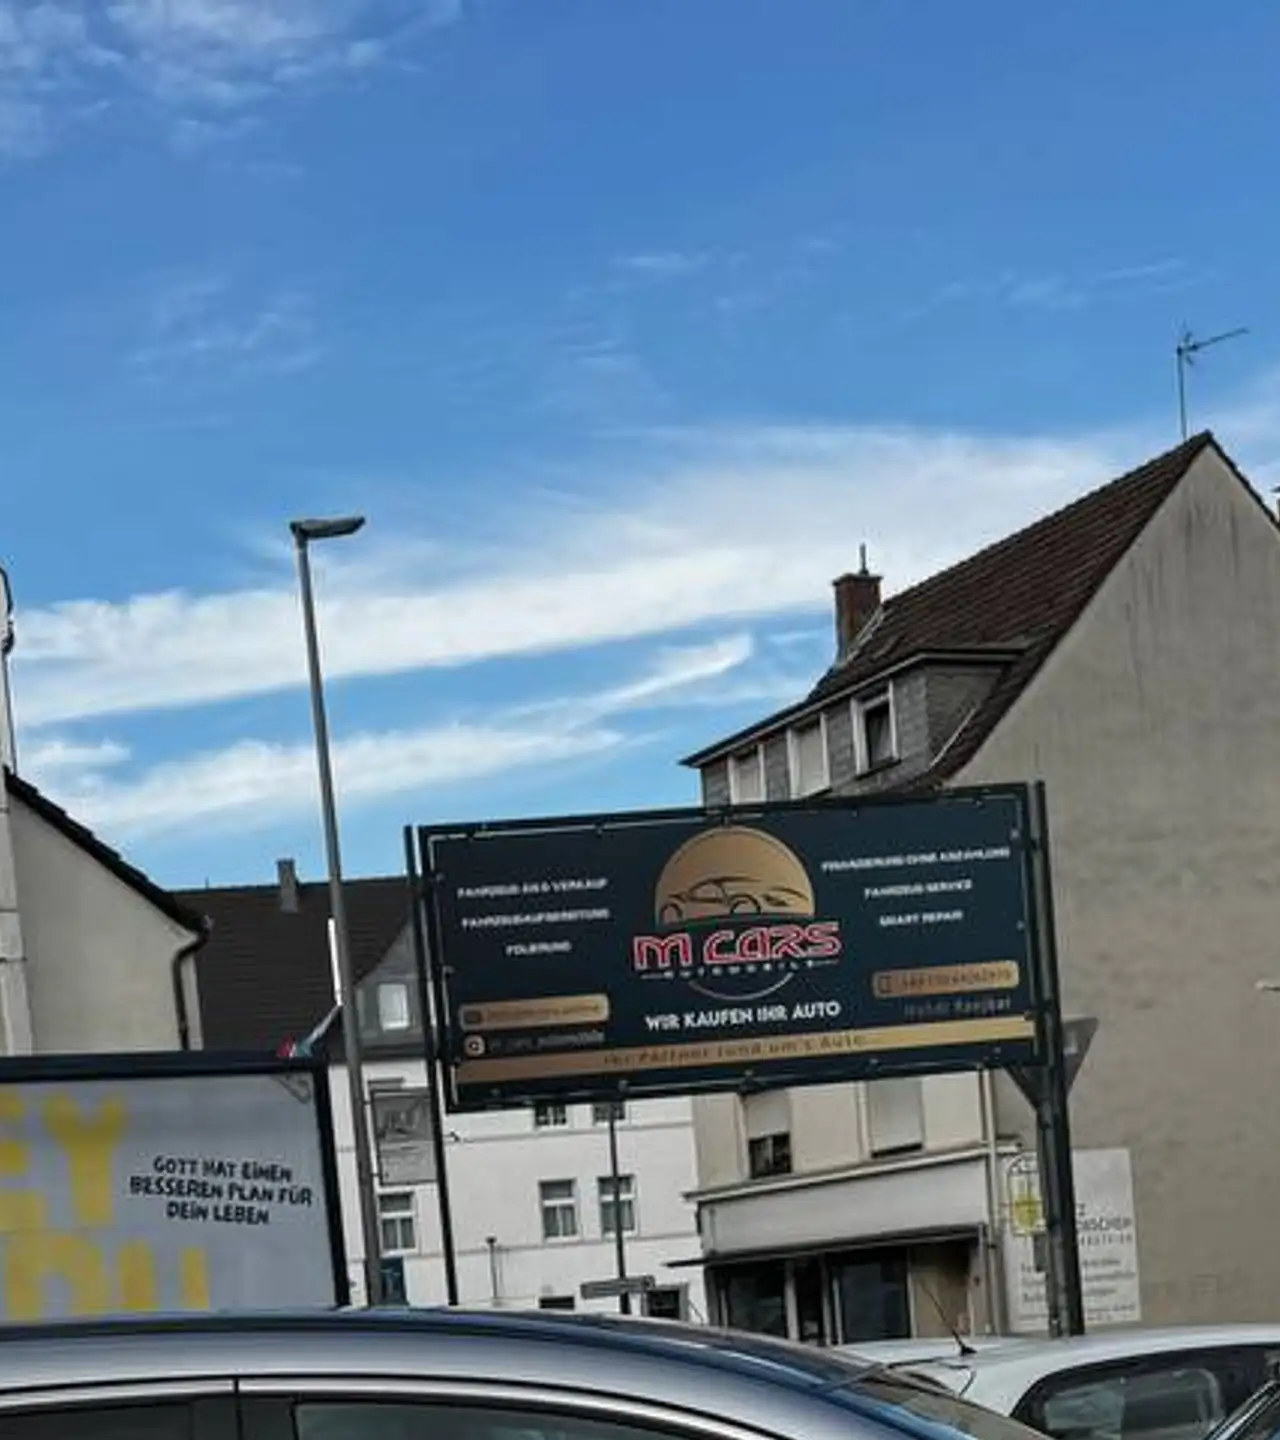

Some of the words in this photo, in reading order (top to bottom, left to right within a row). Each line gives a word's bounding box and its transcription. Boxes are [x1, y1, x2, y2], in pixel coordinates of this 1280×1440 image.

[633, 932, 694, 971] M
[644, 1014, 681, 1031] WIR
[683, 1006, 753, 1029] KAUFEN
[756, 1004, 789, 1021] IHR
[791, 1000, 842, 1020] AUTO
[153, 1155, 198, 1176] GOTT
[202, 1159, 237, 1178] HAT
[129, 1175, 224, 1199] BESSEREN
[228, 1181, 273, 1202] PLAN
[277, 1185, 313, 1207] FÜR
[213, 1203, 270, 1225] LEBEN
